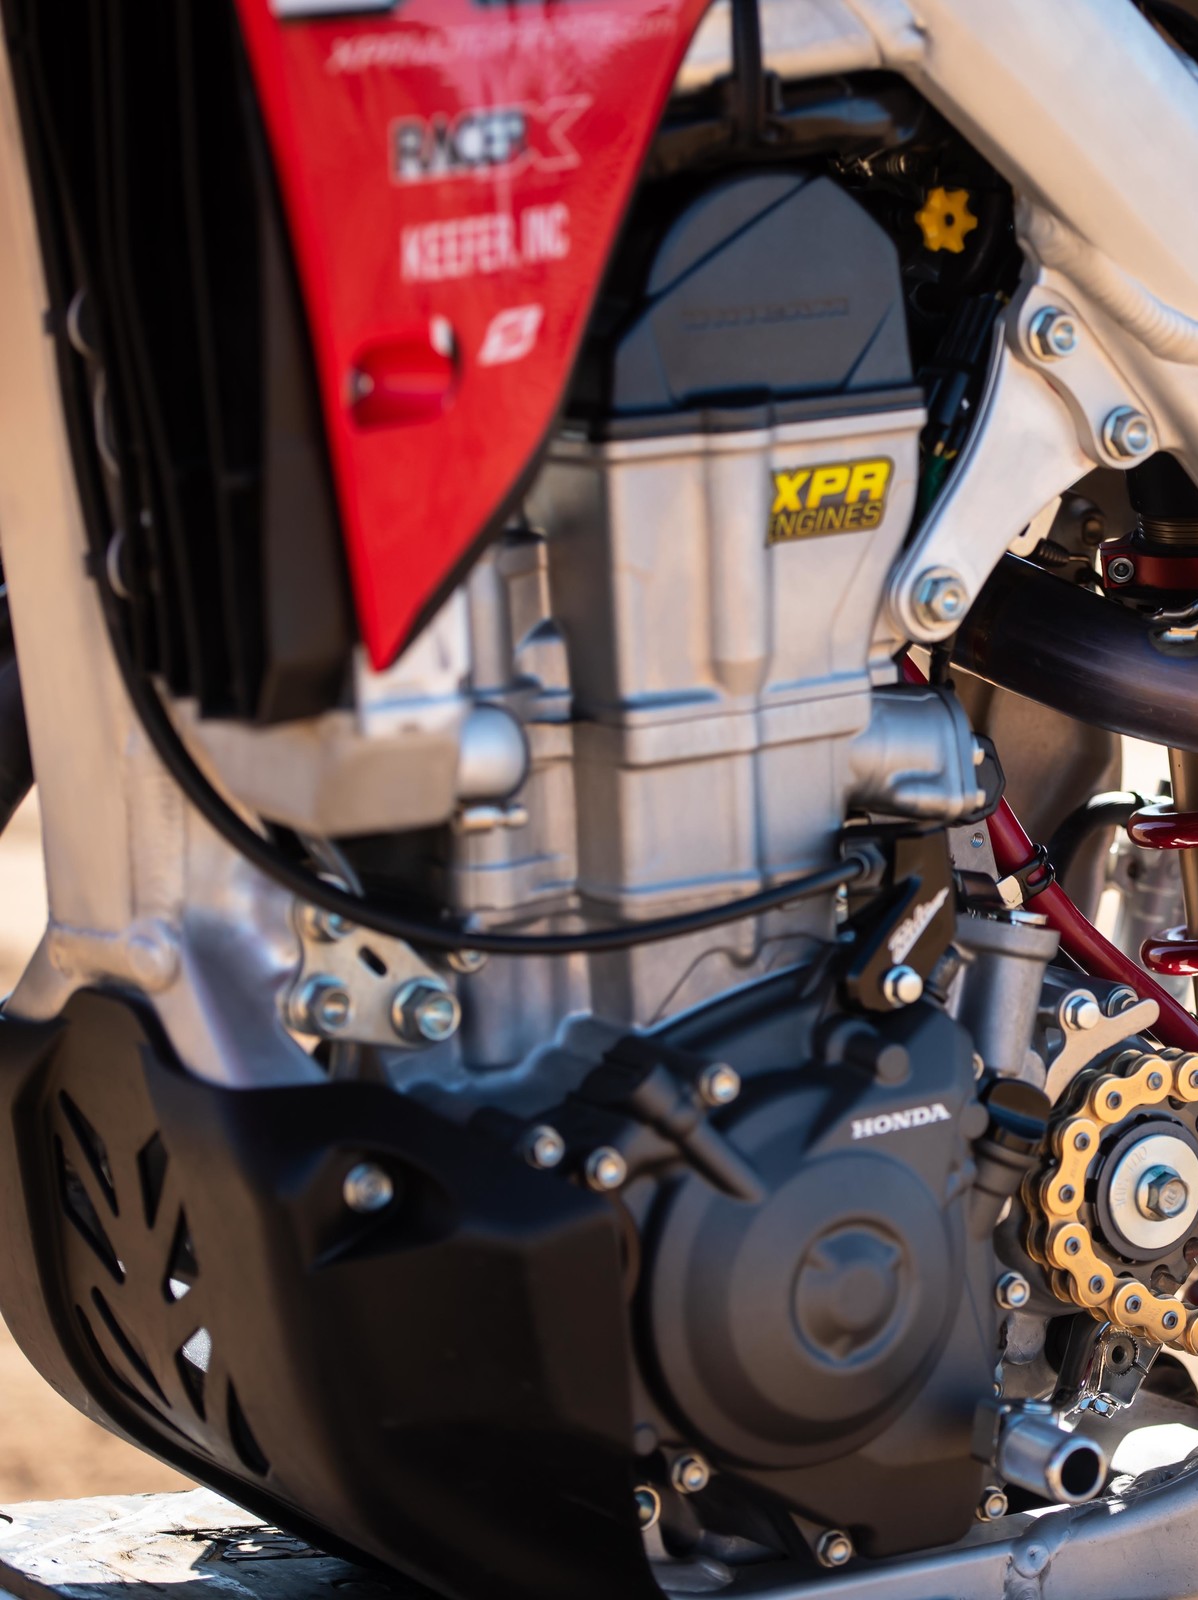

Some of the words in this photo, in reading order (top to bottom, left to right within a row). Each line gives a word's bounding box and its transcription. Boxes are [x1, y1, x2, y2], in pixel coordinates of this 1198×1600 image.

[772, 461, 890, 513] XPR
[771, 500, 882, 538] NGINES
[851, 1103, 951, 1139] HONDA
